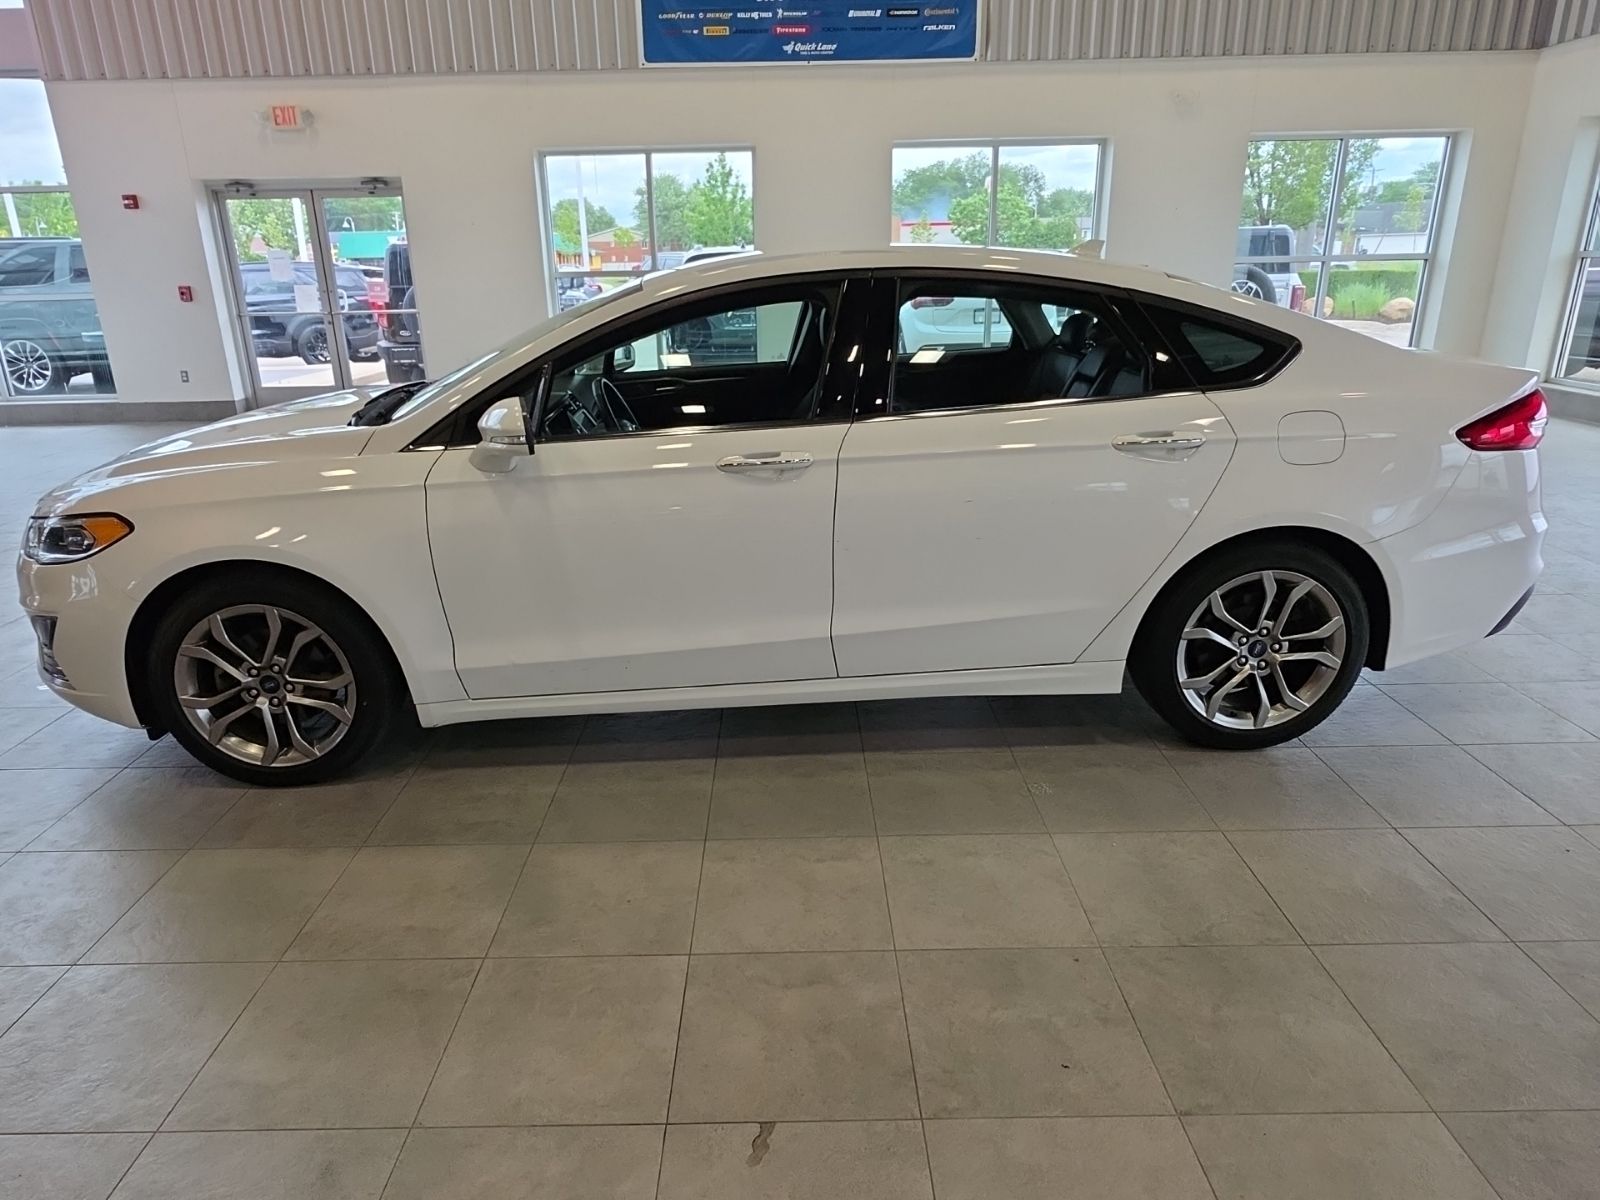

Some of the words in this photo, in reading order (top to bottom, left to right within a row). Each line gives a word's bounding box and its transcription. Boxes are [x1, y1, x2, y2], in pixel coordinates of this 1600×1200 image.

[794, 42, 817, 52] Quick
[817, 42, 838, 51] Lane
[272, 105, 296, 126] EXIT
